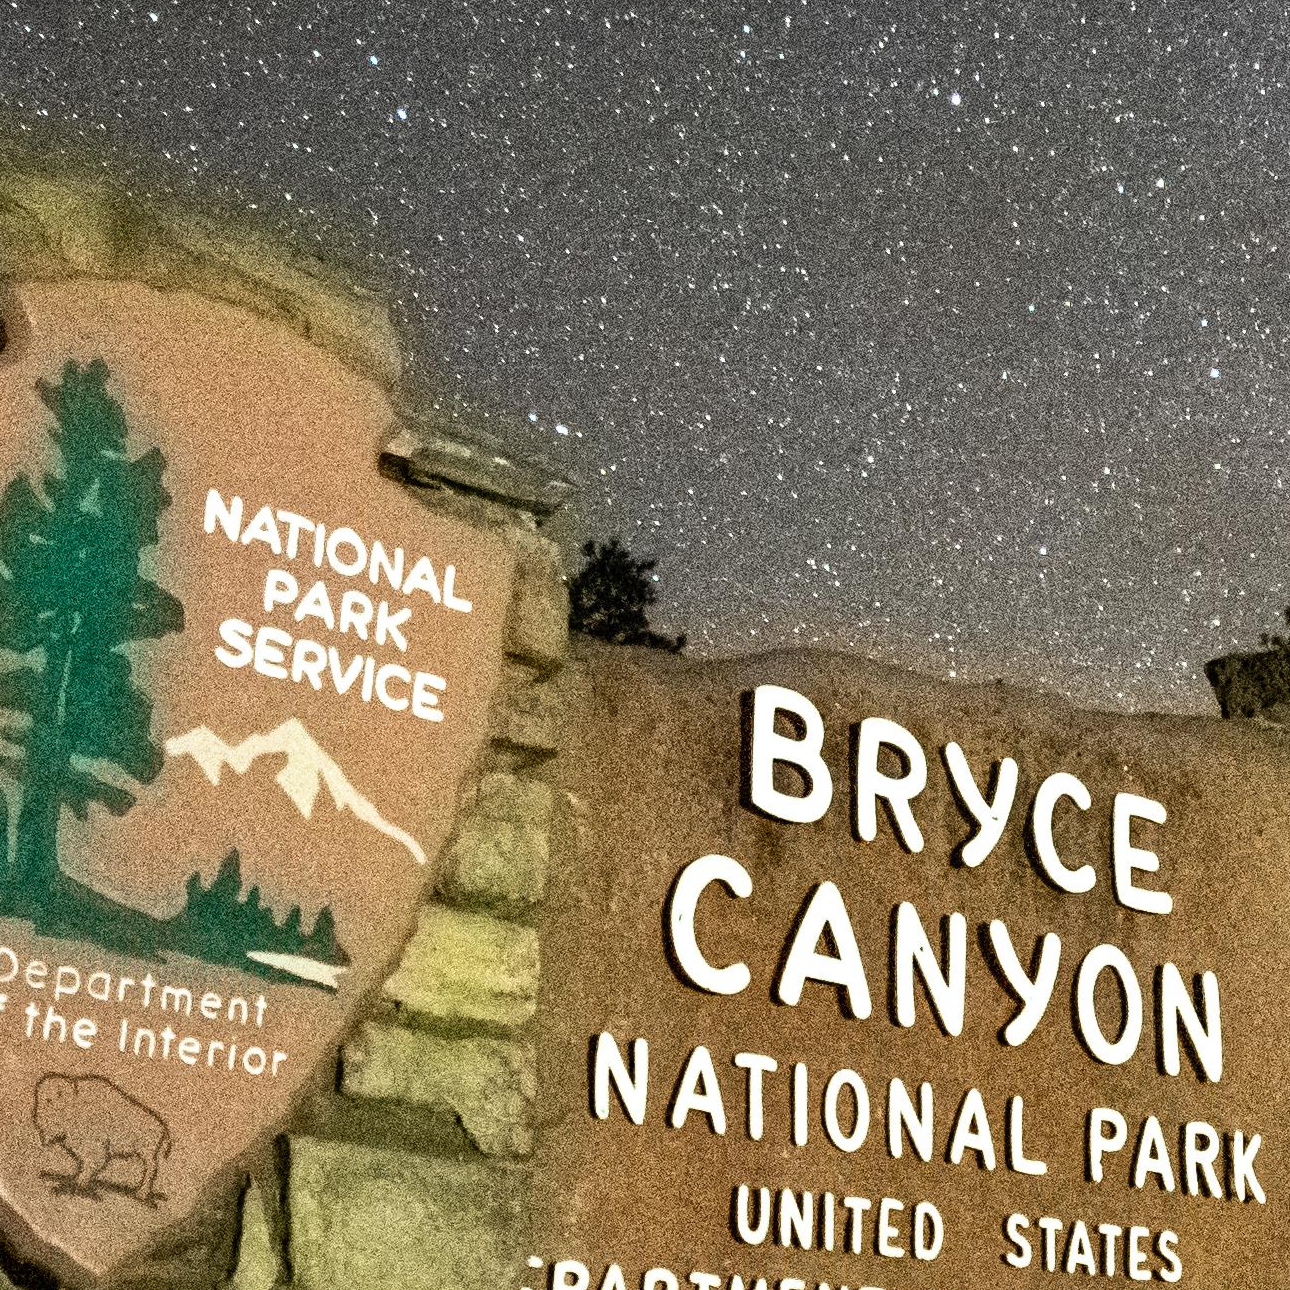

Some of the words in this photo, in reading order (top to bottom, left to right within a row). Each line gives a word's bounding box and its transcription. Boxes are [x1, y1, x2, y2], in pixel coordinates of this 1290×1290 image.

[204, 490, 473, 614] NATIONAL
[264, 569, 413, 651] PARK
[215, 619, 446, 721] SERVICE
[751, 684, 1173, 914] BRYCE
[670, 854, 1223, 1083] CANYON
[25, 1003, 99, 1049] the
[119, 1017, 287, 1077] Interior
[593, 1032, 1047, 1175] NATIONAL
[1090, 1108, 1266, 1204] PARK
[737, 1184, 945, 1260] UNITED
[1007, 1213, 1182, 1283] STATES
